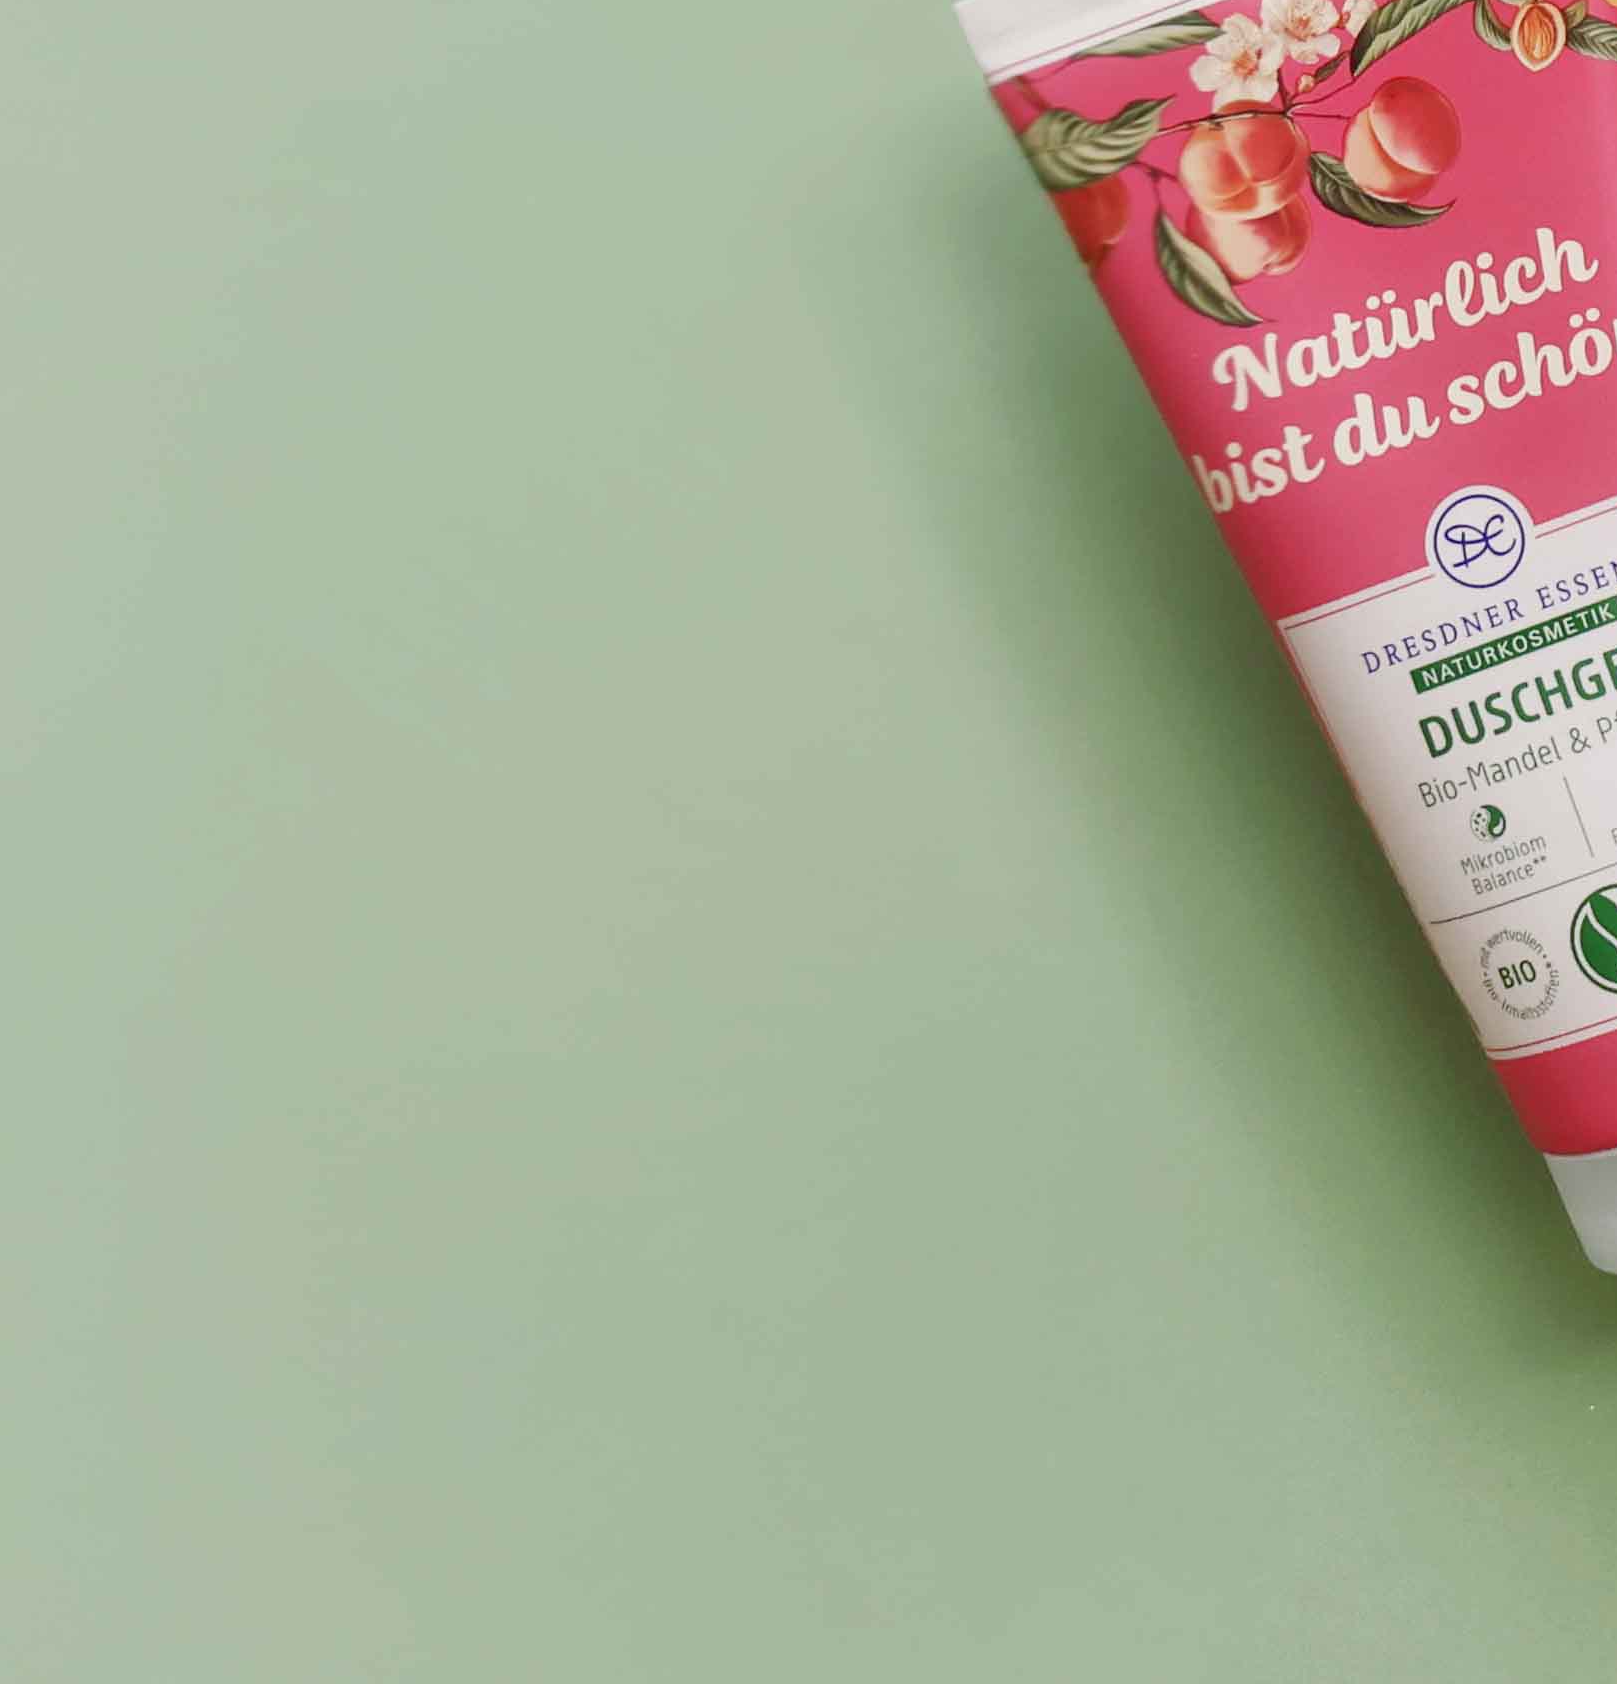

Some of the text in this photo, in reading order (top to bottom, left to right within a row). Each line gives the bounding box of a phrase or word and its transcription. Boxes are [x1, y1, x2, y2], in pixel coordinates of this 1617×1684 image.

[1211, 227, 1599, 411] Natürlich
[1193, 425, 1325, 514] bist
[1333, 393, 1440, 467] du
[1361, 598, 1525, 674] DRESDNER
[1420, 602, 1616, 689] NATURKOSMETIK
[1417, 736, 1564, 808] Bio-Mandel
[1570, 727, 1592, 753] &
[1460, 834, 1547, 876] Mikrobiom
[1498, 960, 1536, 989] BIO
